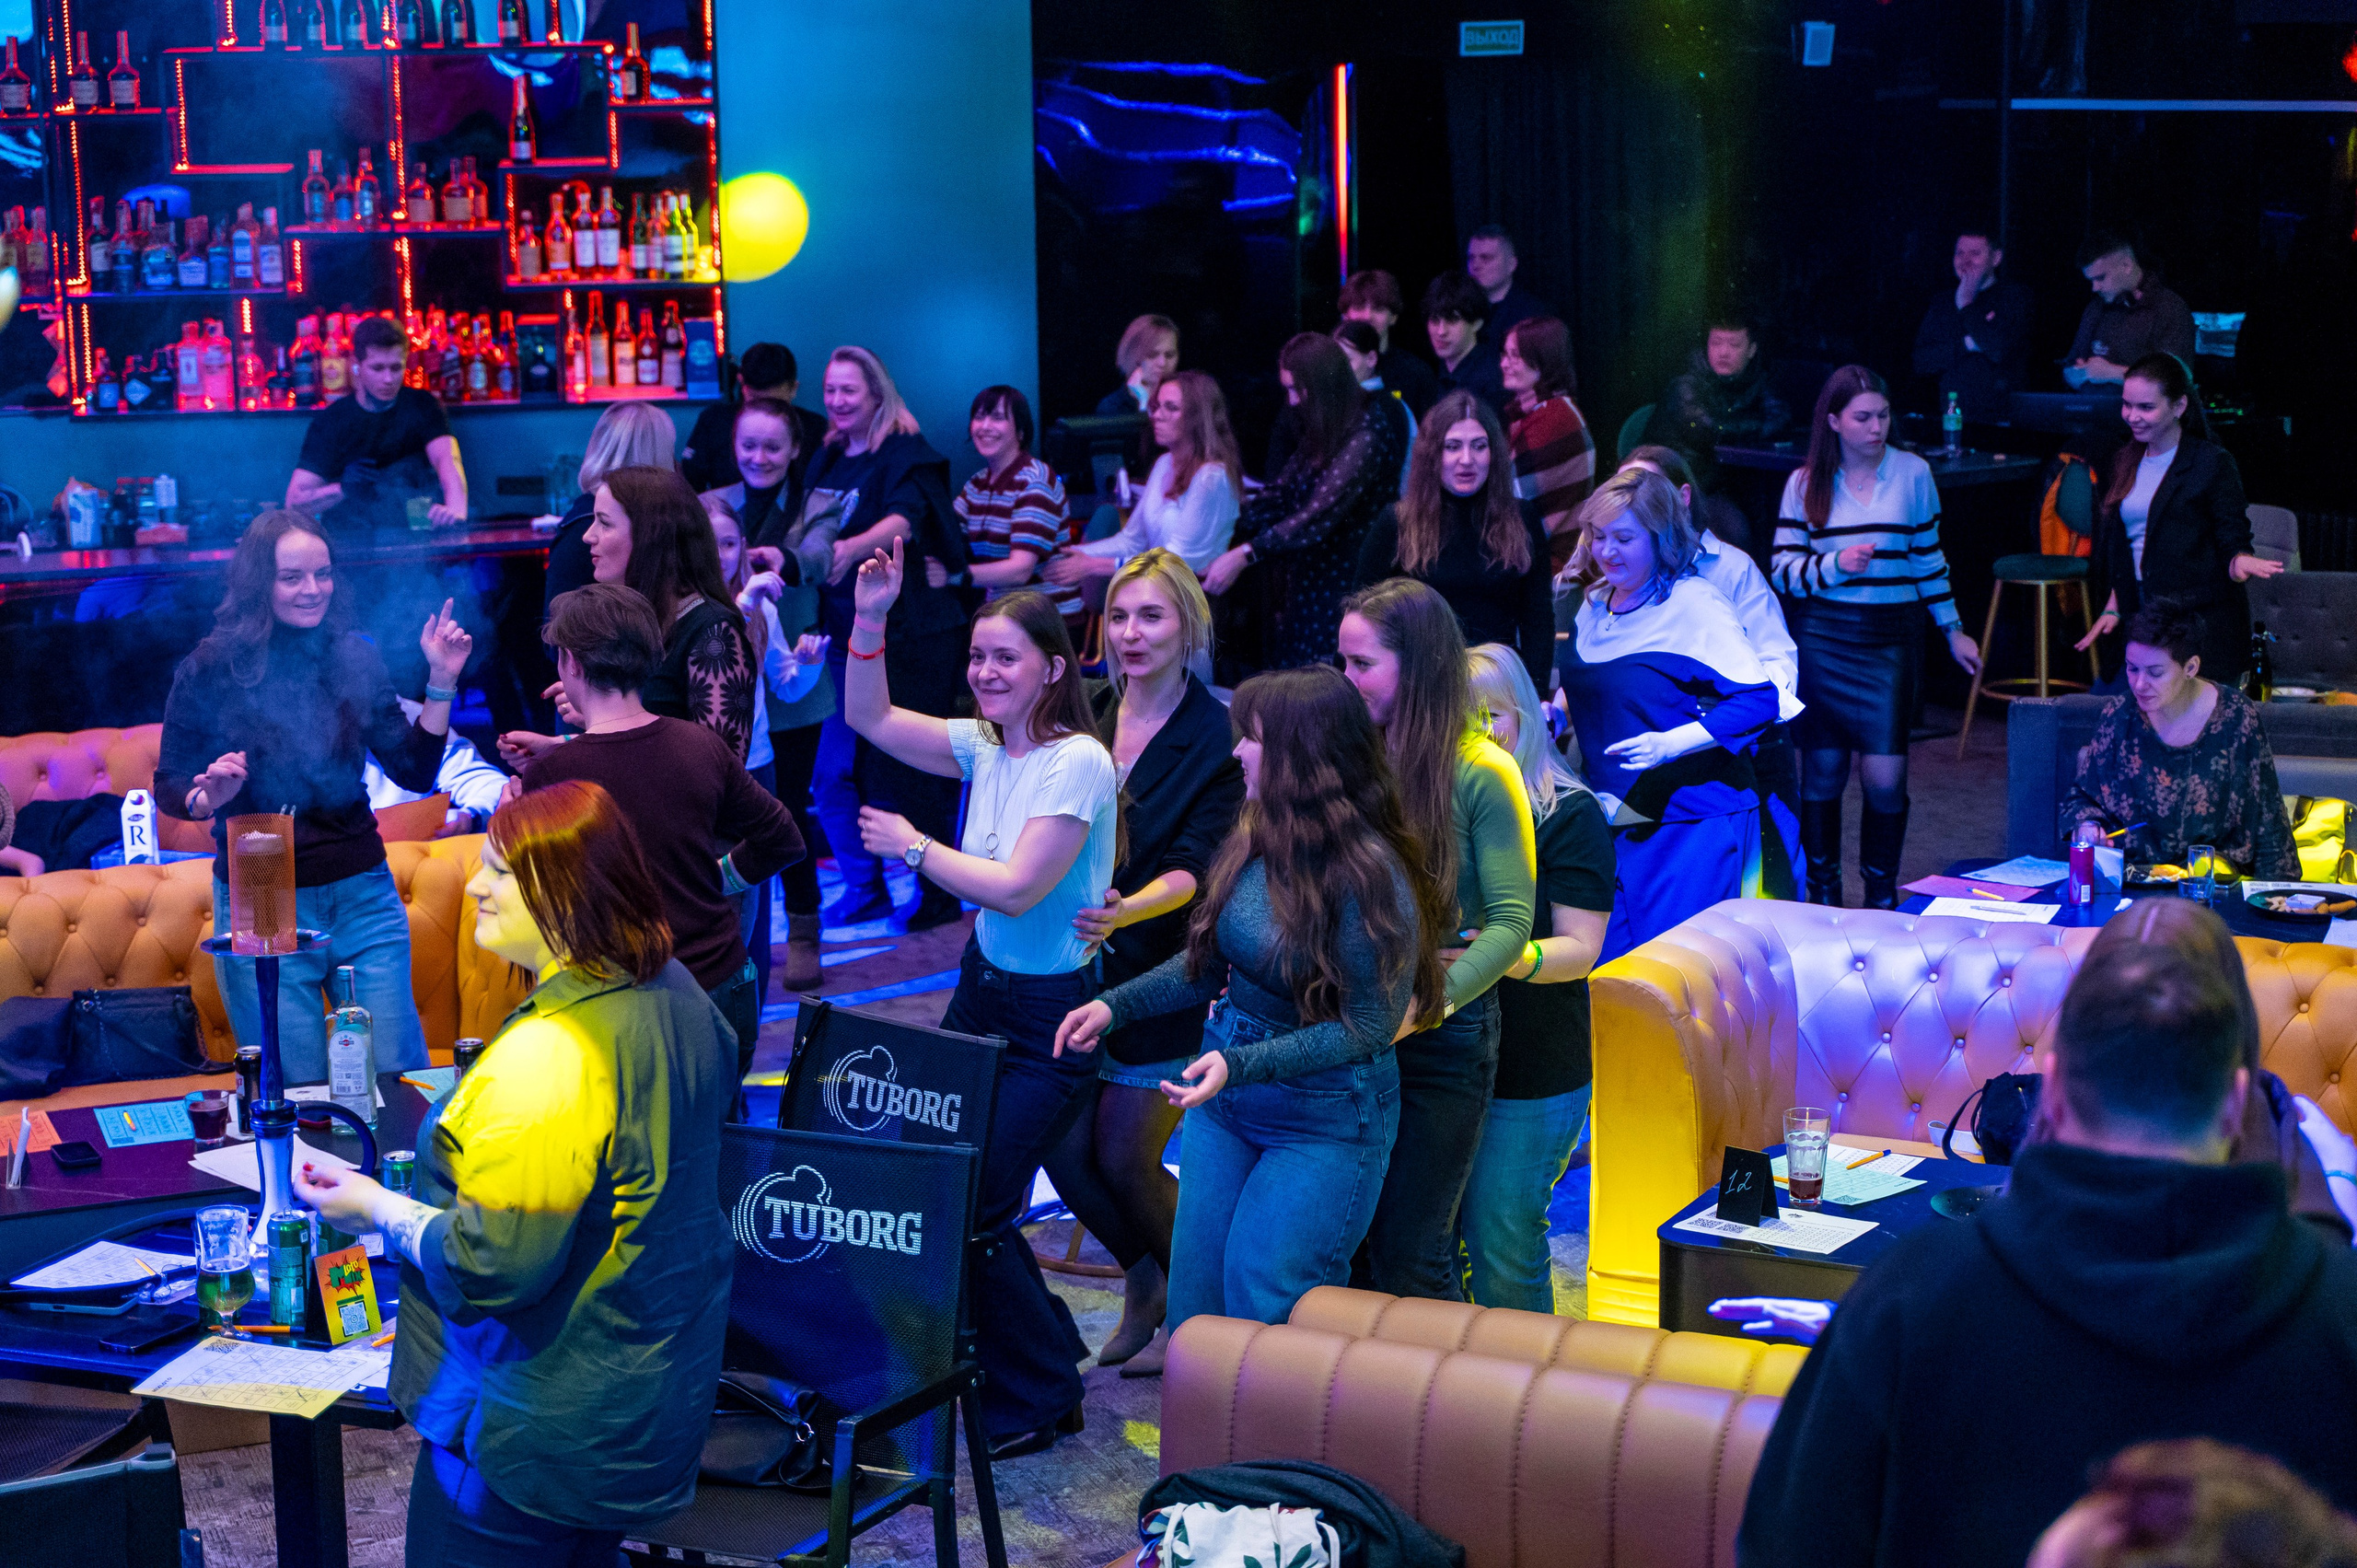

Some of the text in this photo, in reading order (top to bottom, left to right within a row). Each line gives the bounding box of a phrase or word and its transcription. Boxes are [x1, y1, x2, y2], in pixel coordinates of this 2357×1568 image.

[847, 1070, 962, 1132] TUBORG
[1724, 1169, 1753, 1194] 12
[764, 1195, 923, 1255] TUBORG
